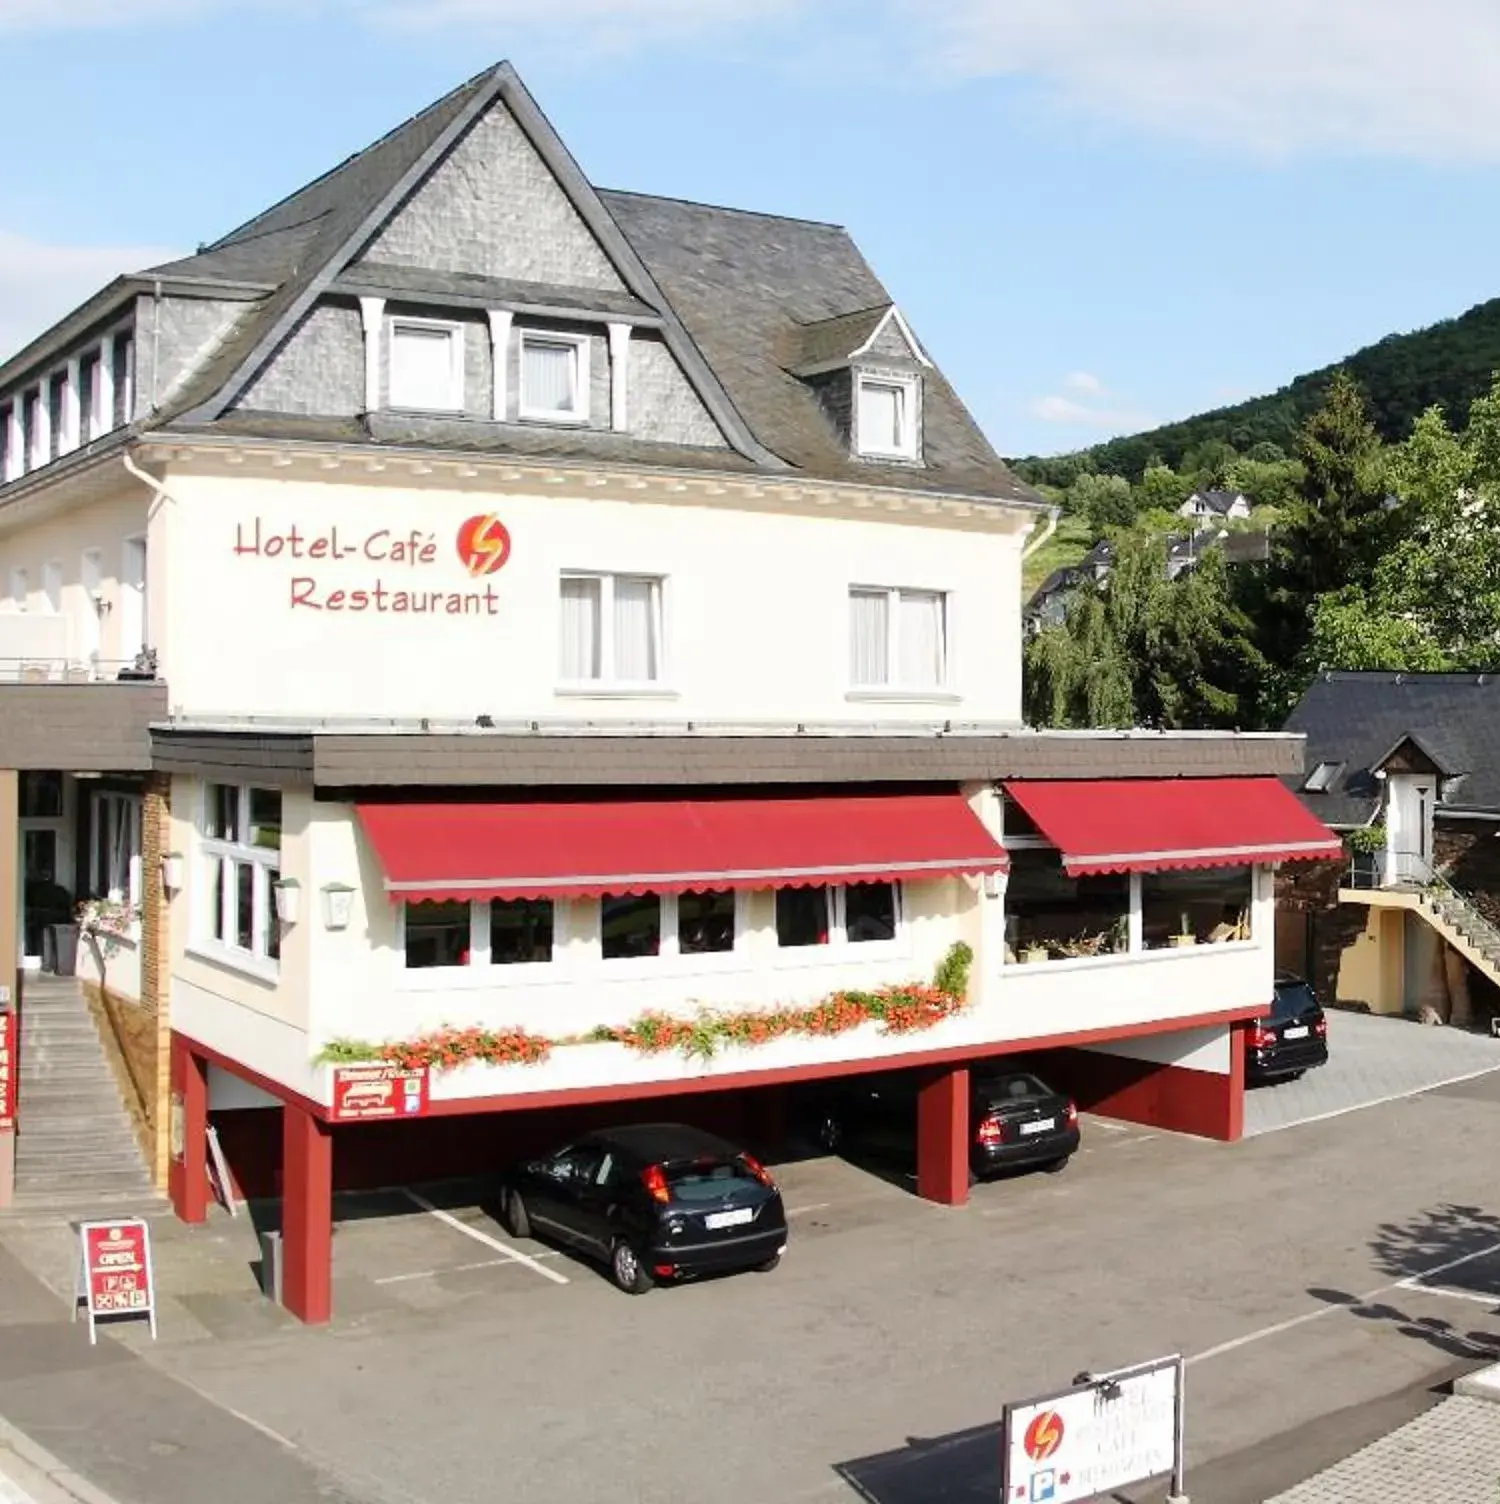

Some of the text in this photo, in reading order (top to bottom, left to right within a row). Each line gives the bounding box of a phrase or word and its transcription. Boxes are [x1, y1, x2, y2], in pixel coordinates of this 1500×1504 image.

[233, 516, 437, 566] Hotel-Café
[290, 577, 499, 615] Restaurant
[99, 1252, 134, 1265] OPEN
